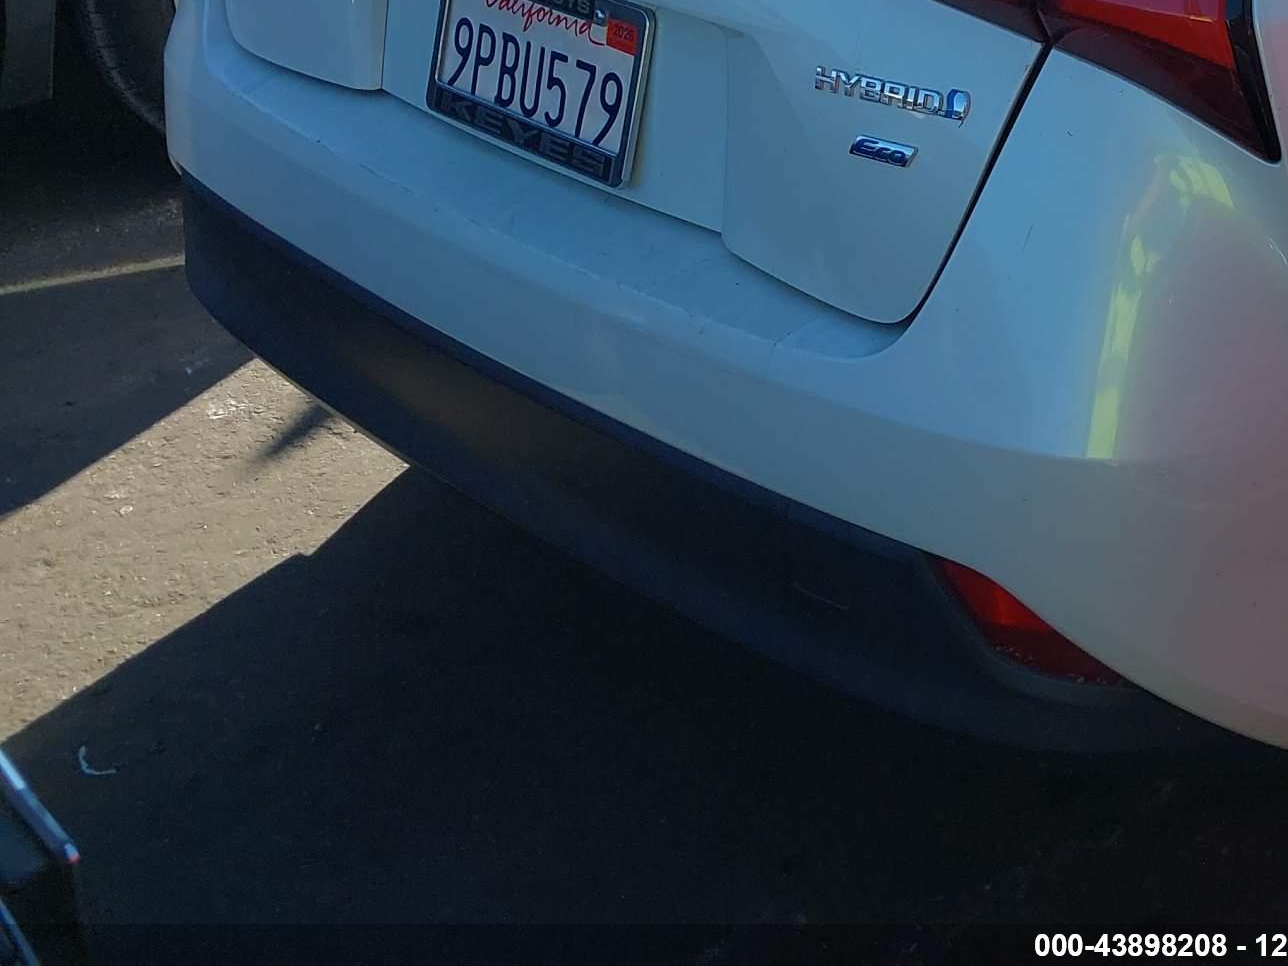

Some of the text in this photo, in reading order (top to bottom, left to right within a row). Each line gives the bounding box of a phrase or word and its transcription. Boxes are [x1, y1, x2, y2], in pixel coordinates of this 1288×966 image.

[612, 26, 635, 42] 2026
[447, 17, 623, 146] 9PBU579
[815, 65, 945, 116] HYBRID
[444, 91, 605, 176] KEYES
